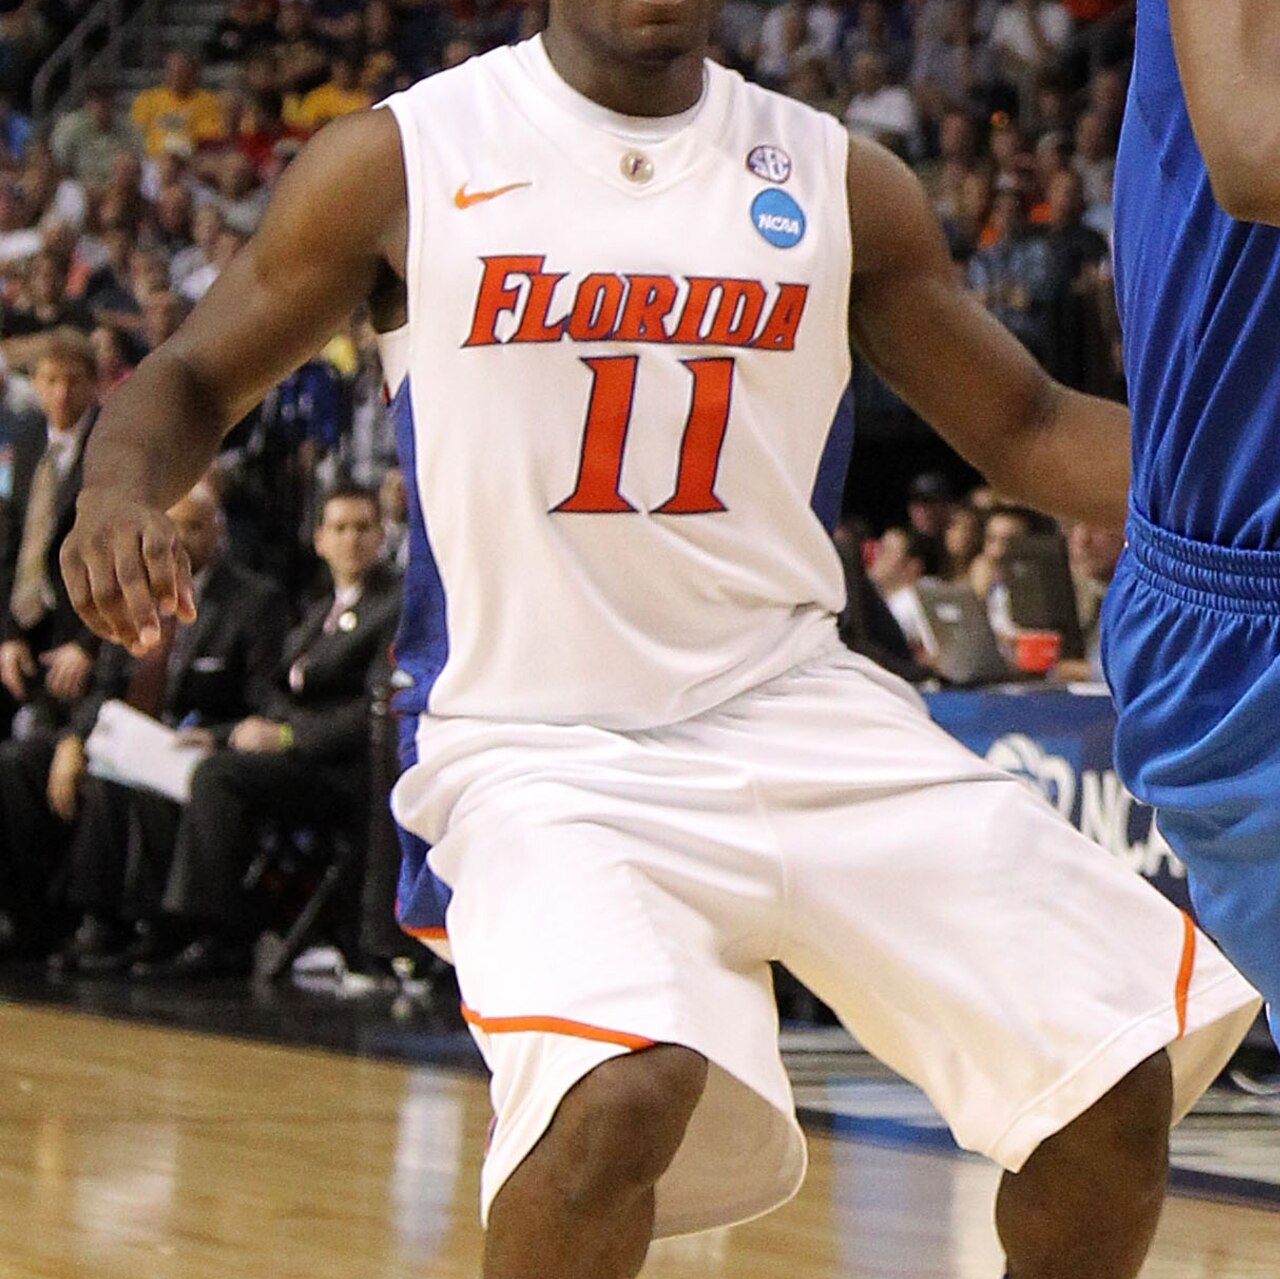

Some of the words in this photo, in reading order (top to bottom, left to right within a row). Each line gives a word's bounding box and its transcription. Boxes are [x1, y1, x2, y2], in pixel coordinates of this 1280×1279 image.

[758, 214, 800, 236] NCAA
[460, 254, 809, 352] FLORIDA
[547, 355, 735, 515] 11
